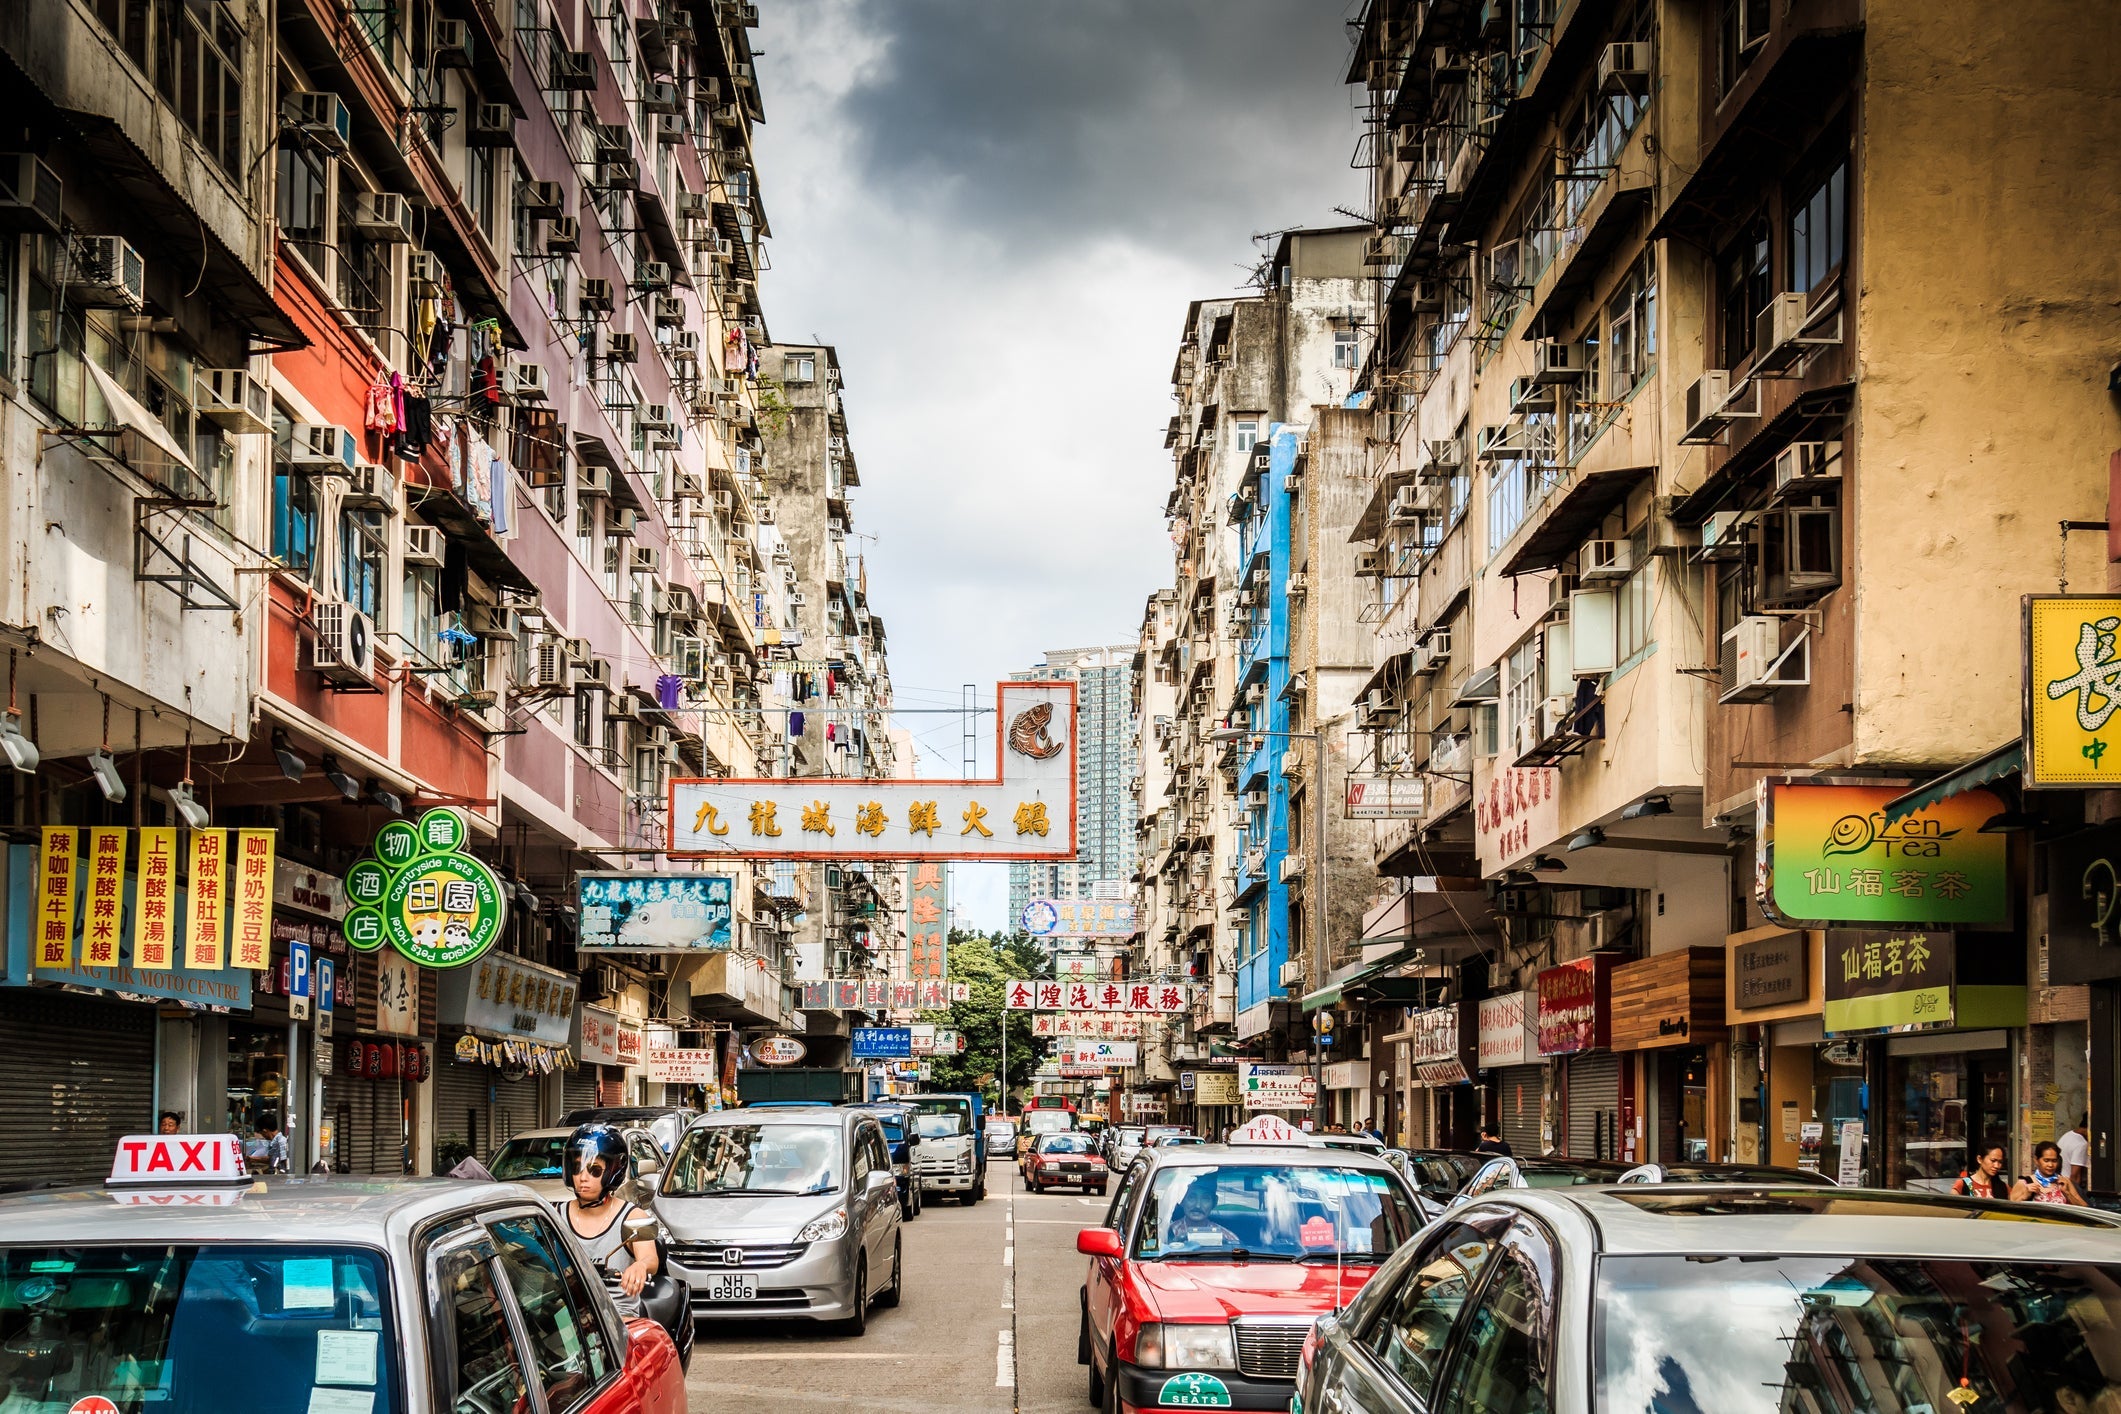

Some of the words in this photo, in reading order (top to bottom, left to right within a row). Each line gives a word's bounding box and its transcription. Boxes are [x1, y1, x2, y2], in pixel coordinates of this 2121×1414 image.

[693, 800, 1050, 838] 九龍城海鮮火鍋
[1879, 840, 1941, 858] Tea
[390, 858, 443, 902] Countryside
[448, 858, 474, 877] Pets
[474, 875, 494, 904] Hotel
[408, 880, 478, 913] 田園
[1803, 868, 1973, 900] 仙福茗茶
[43, 833, 70, 962] 辣咖哩牛腩飯
[89, 834, 119, 961] 麻辣酸辣米線
[142, 835, 168, 963] 上海酸辣湯麵
[194, 836, 219, 964] 胡椒豬肚湯麵
[240, 837, 268, 964] 咖啡奶茶豆漿
[390, 916, 410, 945] Hotel
[441, 917, 493, 962] Countryside
[410, 943, 436, 962] Pets
[1841, 934, 1931, 983] 仙福茗茶
[139, 969, 183, 992] MOTO
[187, 979, 241, 1001] CENTRE
[294, 949, 307, 991] P
[321, 965, 332, 1006] P
[1009, 982, 1184, 1010] 金煌汽車服務
[1097, 1044, 1113, 1055] SK
[1247, 1129, 1293, 1141] TAXI
[1259, 1118, 1281, 1129] 的士
[123, 1141, 221, 1172] TAXI
[231, 1140, 244, 1172] 的士
[714, 1287, 752, 1299] 8906
[723, 1275, 743, 1287] NH
[1173, 1374, 1213, 1385] TAXI
[1189, 1381, 1201, 1395] 5
[1172, 1395, 1218, 1404] SEATS
